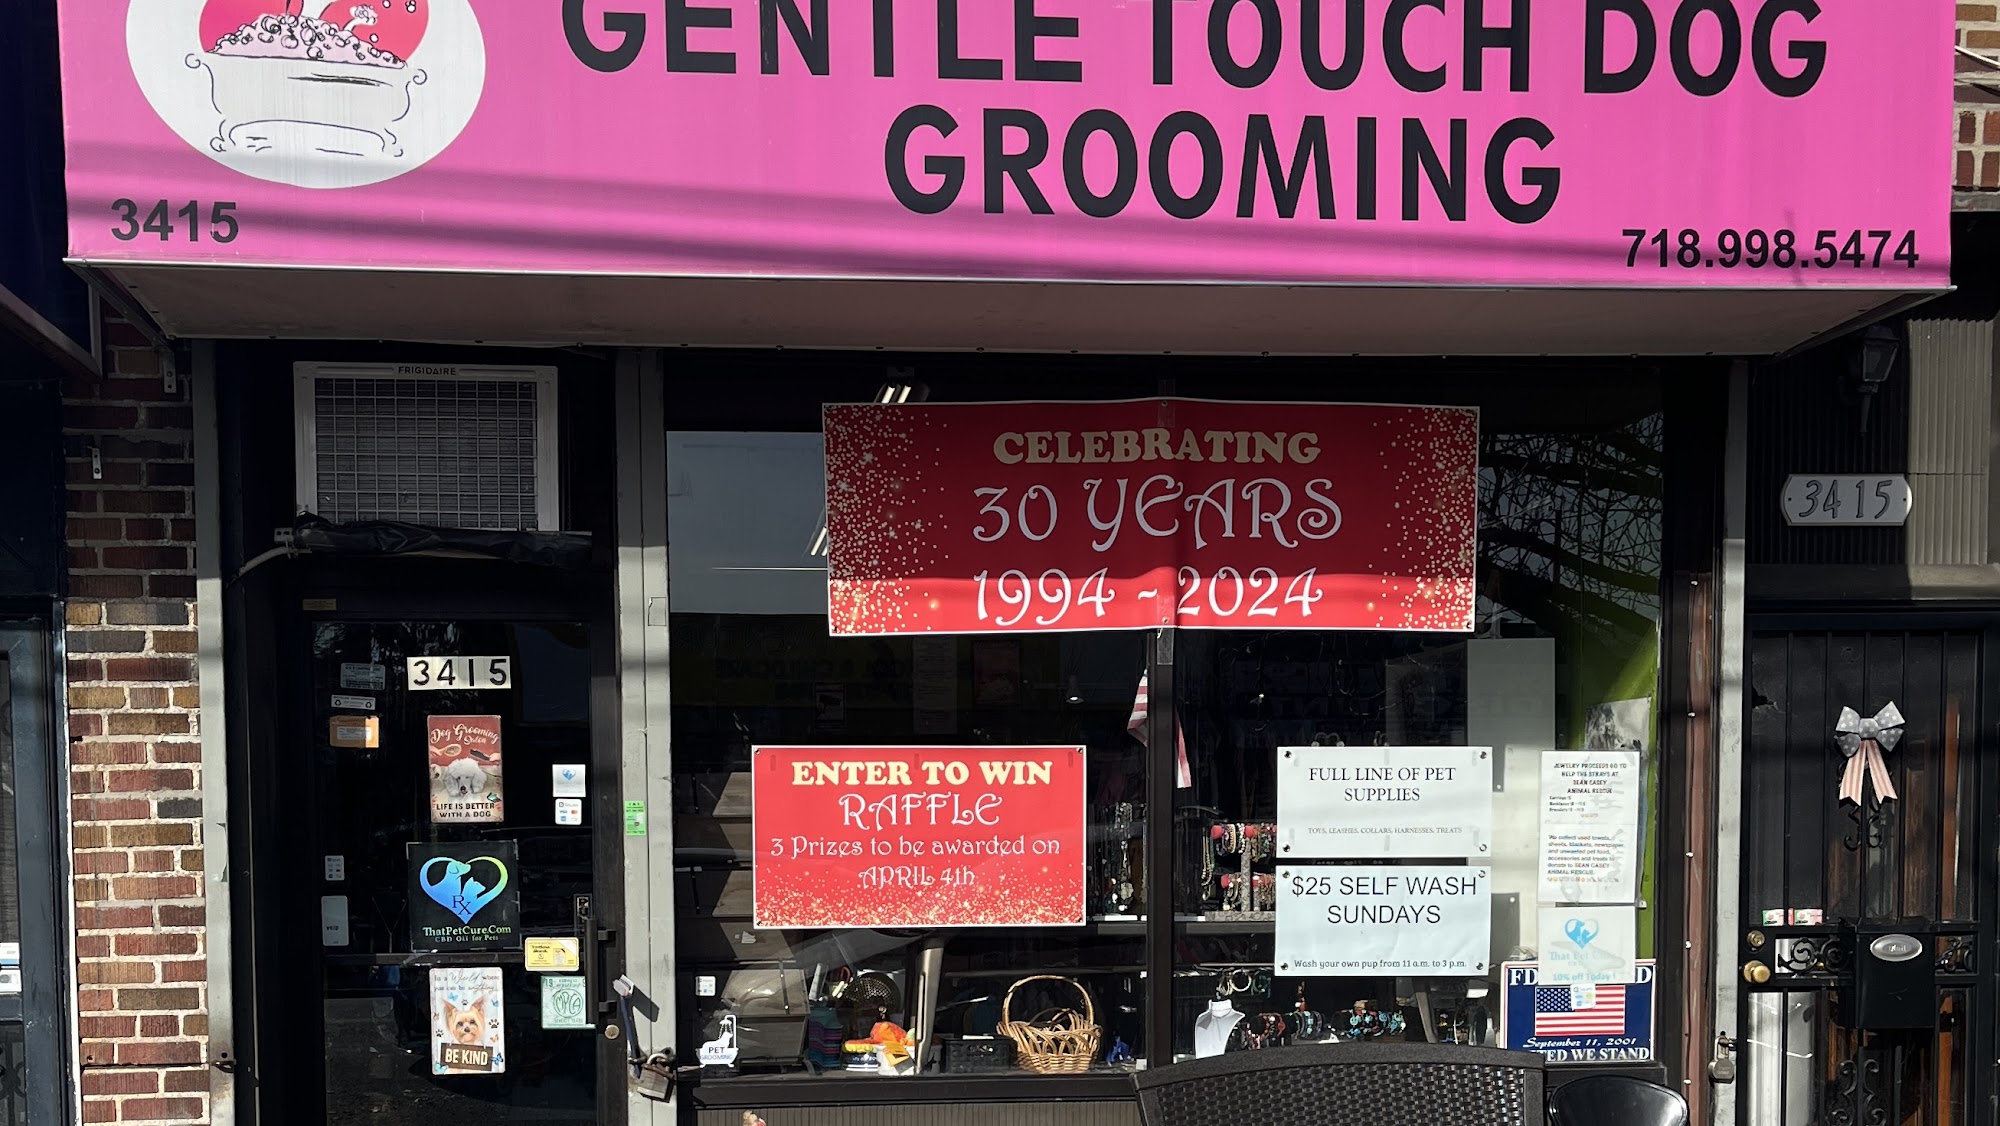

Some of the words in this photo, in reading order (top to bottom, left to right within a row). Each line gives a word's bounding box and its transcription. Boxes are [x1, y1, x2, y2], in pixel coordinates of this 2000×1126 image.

[562, 0, 1083, 83] GENTLE
[1151, 0, 1530, 93] TOUCH
[1584, 0, 1828, 98] DOG
[884, 104, 1562, 224] GROOMING
[110, 198, 239, 244] 3415
[1622, 228, 1920, 270] 718.998.5474
[398, 366, 457, 376] FRIGIDAIRE
[992, 428, 1321, 465] CELEBRATING
[1798, 479, 1893, 519] 3415
[972, 485, 1058, 542] 30
[1083, 474, 1343, 552] YEARS
[972, 567, 1116, 627] 1994
[1177, 566, 1324, 618] 2024
[412, 658, 508, 687] 3415
[431, 728, 451, 744] Dog
[453, 723, 499, 745] Grooming
[791, 761, 913, 786] ENTER
[921, 761, 970, 786] TO
[979, 761, 1053, 786] WIN
[1309, 767, 1352, 782] FULL
[1355, 767, 1394, 782] LINE
[1397, 767, 1421, 782] OF
[1425, 767, 1457, 782] PET
[1343, 787, 1421, 802] SUPPLIES
[436, 803, 453, 811] LIFE
[466, 802, 495, 810] BETTER
[838, 791, 1003, 832] RAFFLE
[1360, 827, 1393, 835] COLLARS,
[770, 837, 785, 857] 3
[791, 834, 864, 860] Prizes
[870, 836, 893, 856] to
[899, 834, 927, 858] be
[931, 835, 1026, 858] awarded
[1032, 839, 1061, 855] on
[858, 865, 936, 889] APRIL
[940, 866, 976, 887] 4th
[1292, 875, 1332, 898] $25
[1339, 876, 1400, 896] SELF
[1406, 876, 1477, 896] WASH
[1327, 904, 1441, 925] SUNDAYS
[422, 924, 512, 937] ThatPetCure.Com
[1294, 959, 1318, 968] Wash
[1319, 961, 1339, 971] your
[1361, 961, 1378, 971] pup
[1379, 959, 1401, 968] from
[1402, 960, 1412, 968] 11
[1432, 960, 1441, 968] to
[1449, 961, 1467, 971] p.m.
[1552, 973, 1570, 982] 10%
[1572, 972, 1584, 981] off
[1586, 972, 1611, 982] Today
[1523, 1037, 1581, 1049] September
[1585, 1038, 1602, 1047] 11,
[1606, 1038, 1637, 1046] 2001
[1572, 1049, 1598, 1061] WE
[1599, 1047, 1650, 1061] STAND
[445, 1048, 459, 1063] BE
[461, 1049, 488, 1066] KIND
